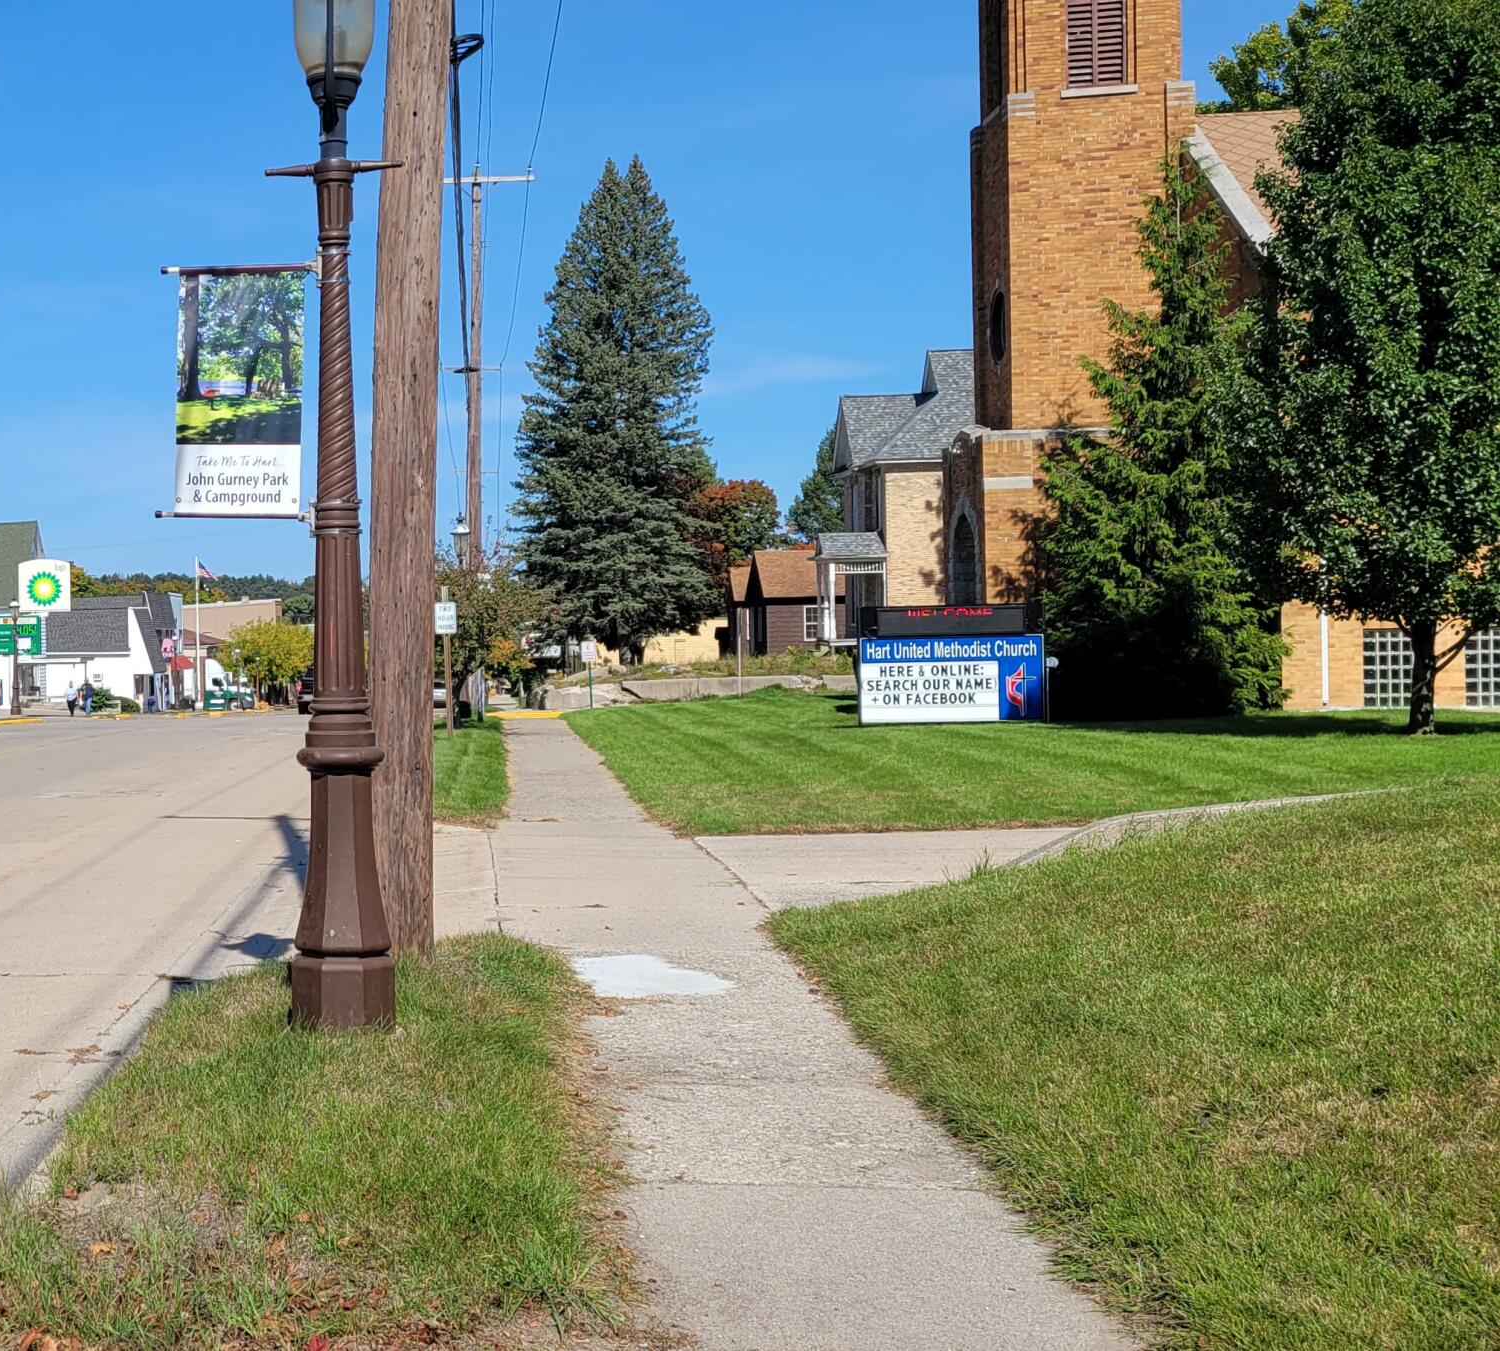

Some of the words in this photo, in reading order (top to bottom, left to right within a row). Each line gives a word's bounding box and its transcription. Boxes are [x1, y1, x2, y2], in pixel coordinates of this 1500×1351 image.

[196, 455, 219, 467] Take
[221, 455, 237, 467] Me
[240, 455, 250, 467] To
[186, 472, 214, 486] John
[217, 472, 259, 488] Gurney
[262, 472, 289, 486] Park
[193, 489, 202, 503] &
[205, 489, 281, 506] Campground
[55, 563, 66, 572] bp
[866, 642, 891, 660] Hart
[893, 641, 931, 659] United
[934, 640, 992, 658] Methodist
[995, 639, 1037, 657] Church
[880, 665, 914, 677] HERE
[918, 665, 925, 677] &
[931, 664, 984, 676] ONLINE:
[923, 679, 950, 690] OUR
[883, 693, 900, 705] ON
[906, 692, 976, 705] FACEBOOK
